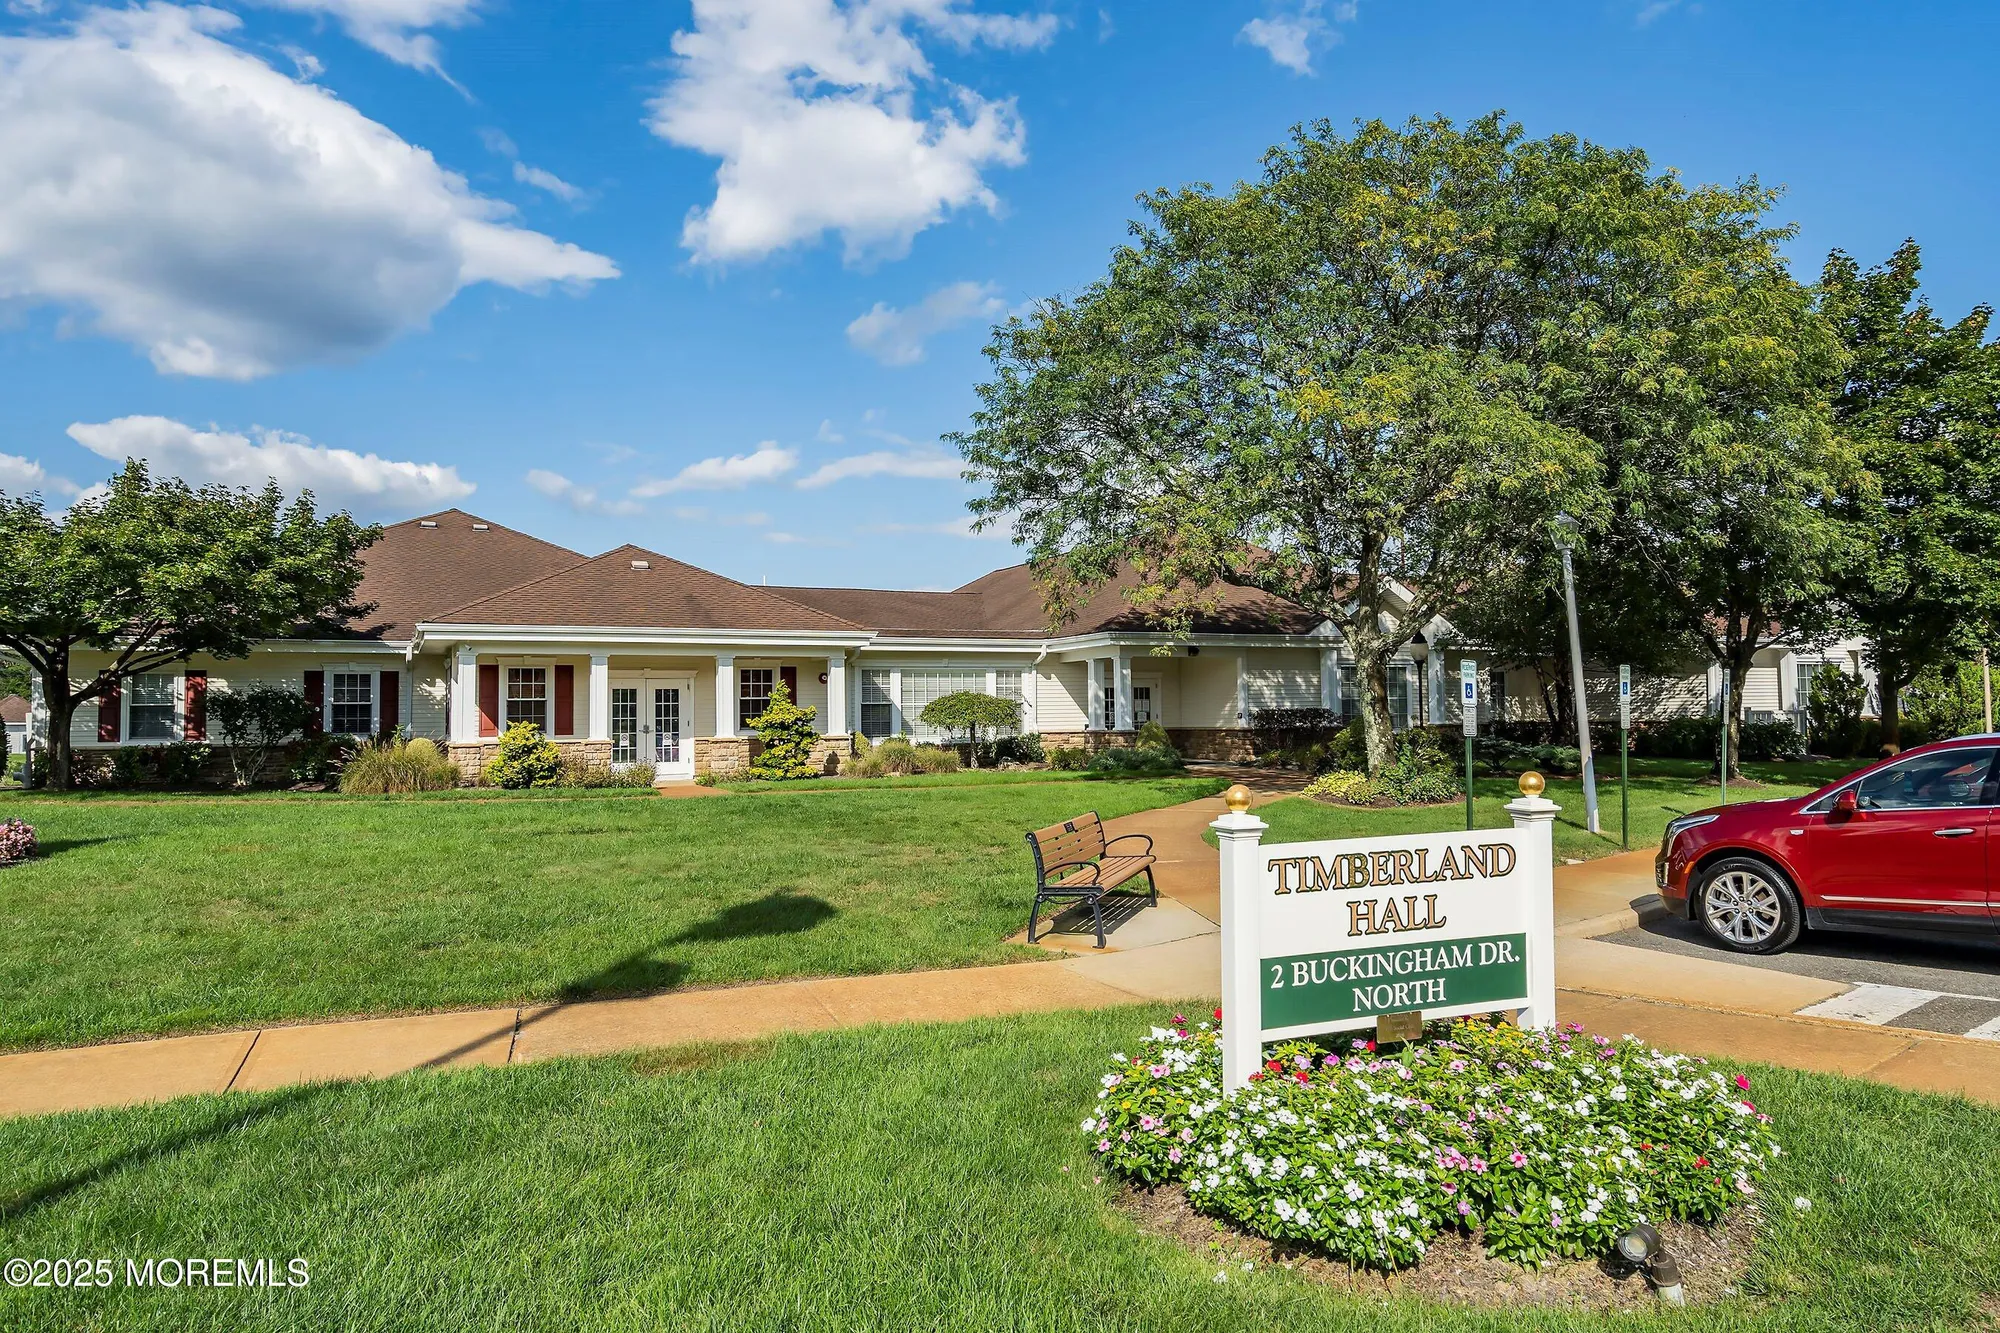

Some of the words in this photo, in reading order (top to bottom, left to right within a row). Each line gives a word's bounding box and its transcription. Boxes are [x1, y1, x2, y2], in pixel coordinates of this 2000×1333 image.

[1268, 843, 1517, 895] TIMBERLAND
[1347, 894, 1447, 937] HALL
[1270, 964, 1285, 990] 2
[1291, 944, 1473, 987] BUCKINGHAM
[1479, 940, 1521, 965] DR.
[1352, 978, 1447, 1012] NORTH
